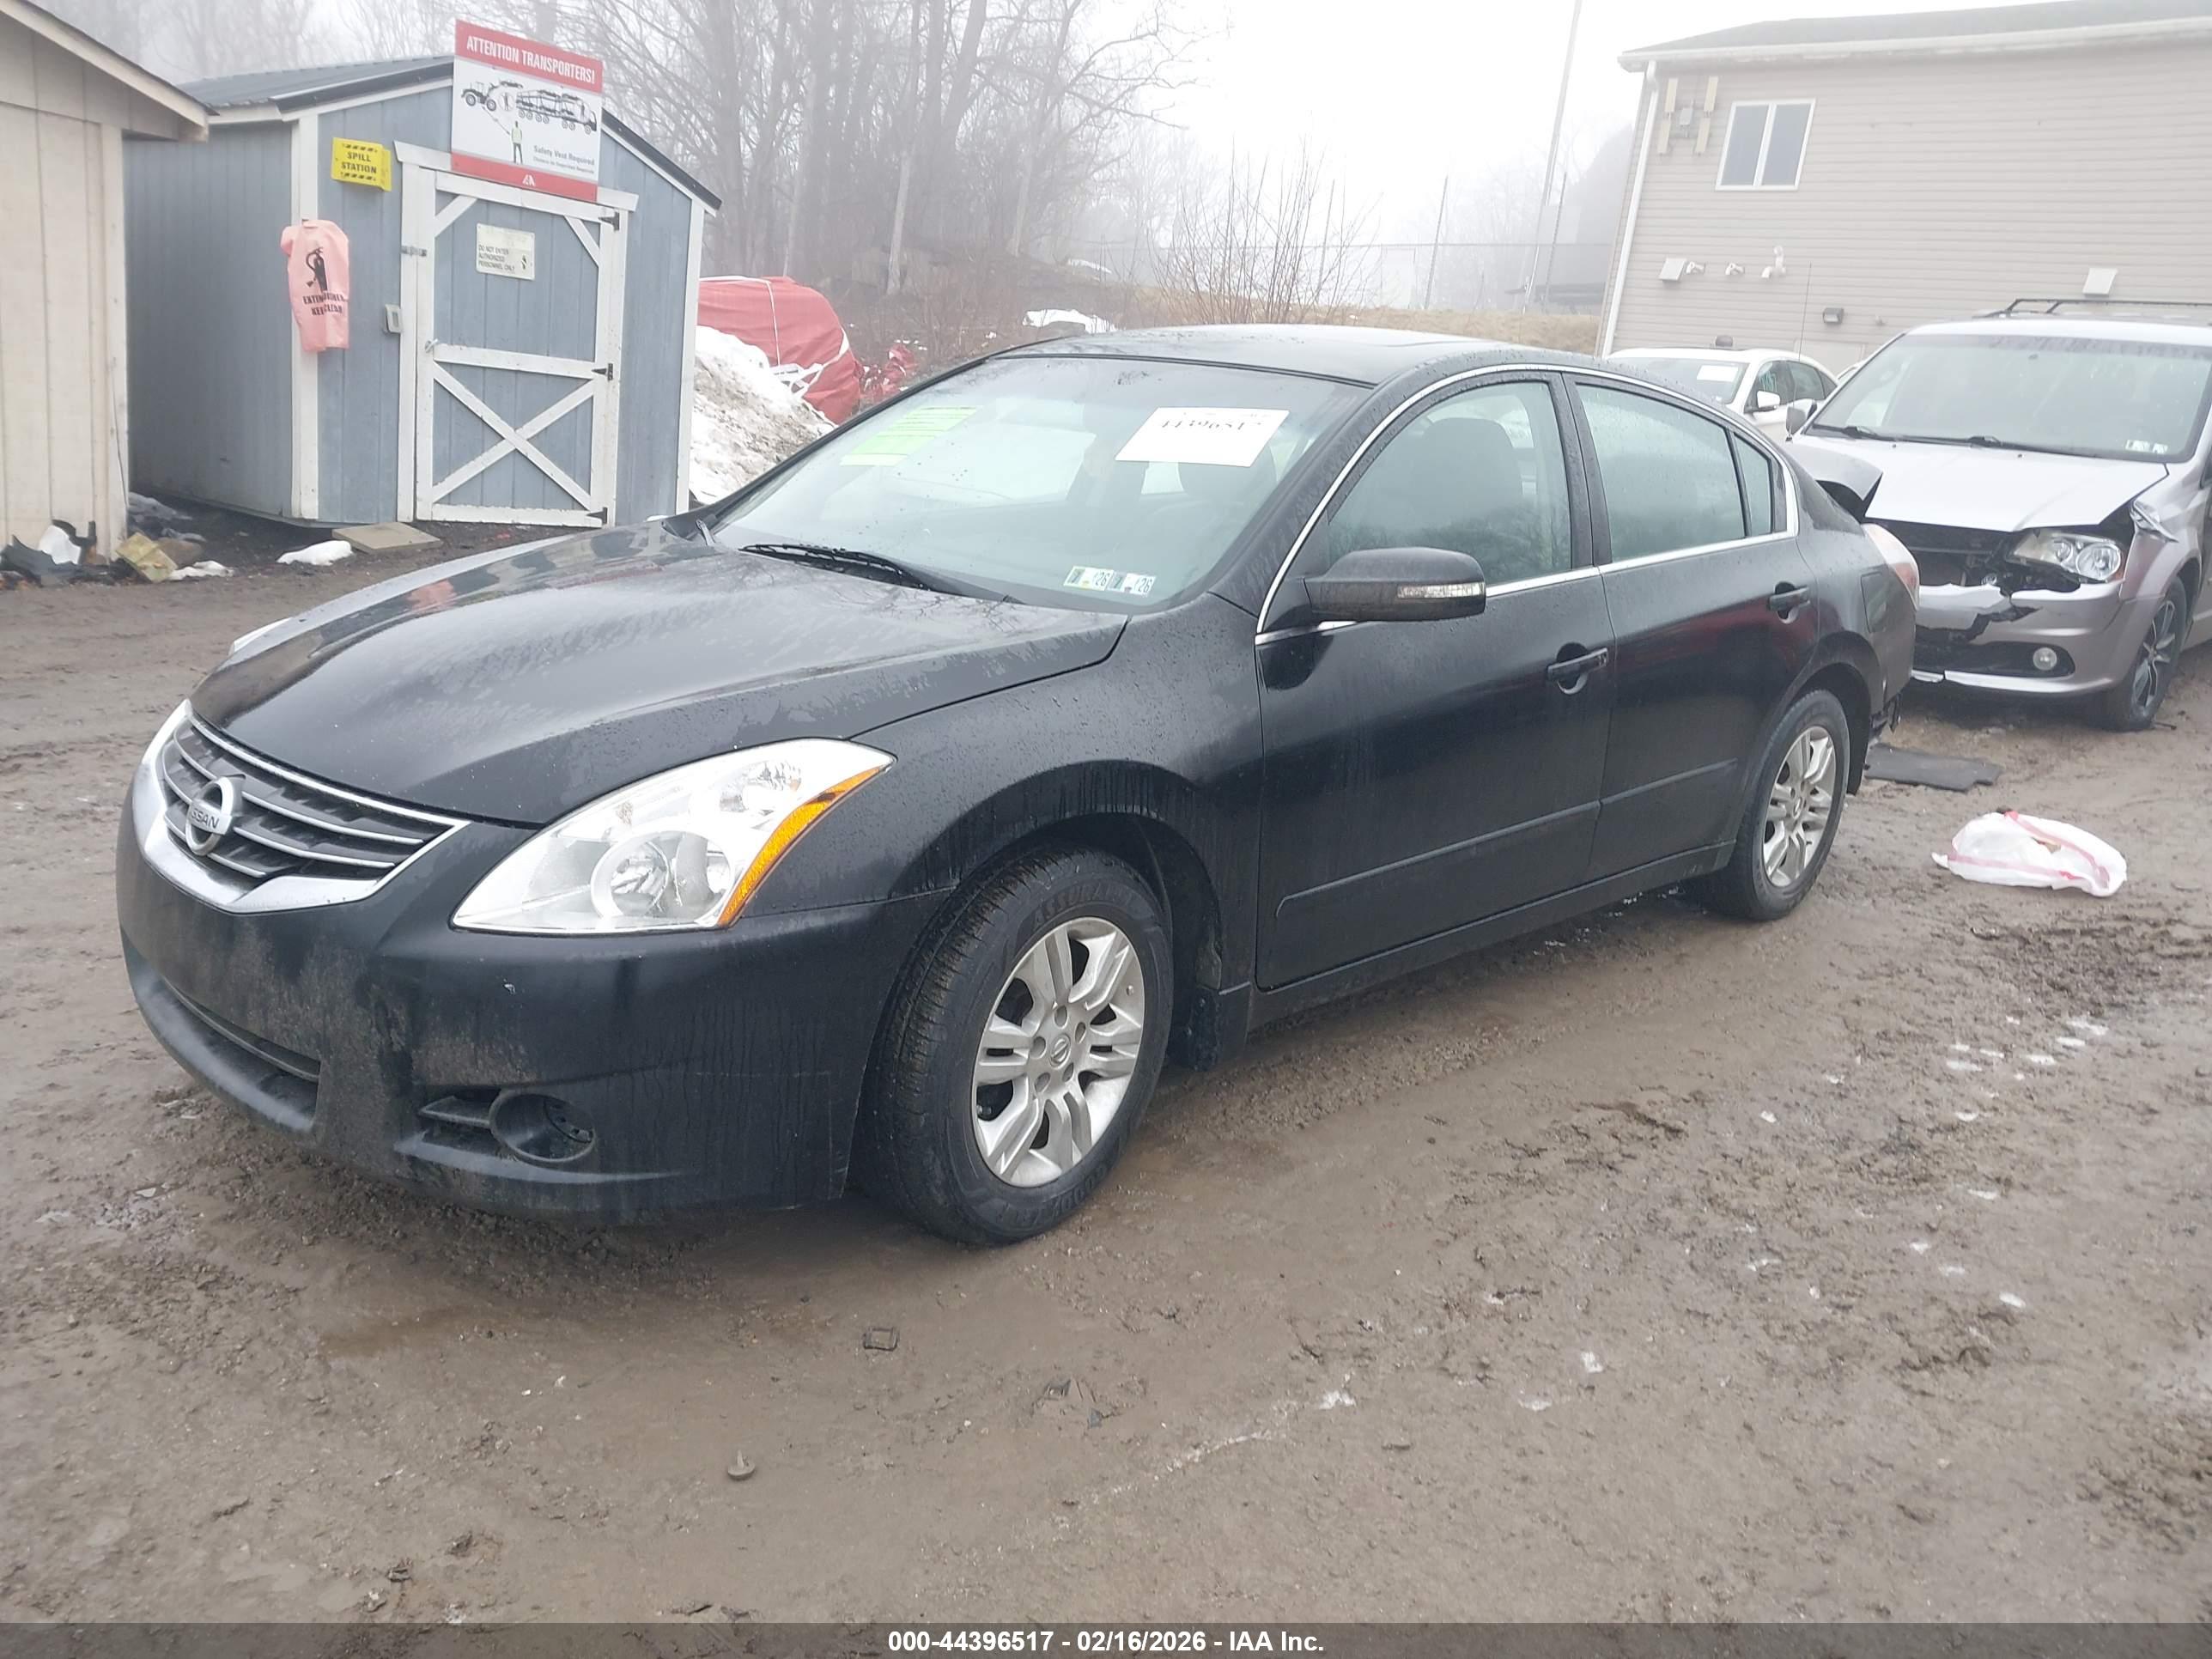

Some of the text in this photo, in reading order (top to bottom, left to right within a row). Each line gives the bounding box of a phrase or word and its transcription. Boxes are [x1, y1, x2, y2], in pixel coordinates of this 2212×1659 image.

[466, 35, 595, 84] ATTENTION TRANSPORTERS!
[347, 151, 371, 162] SPILL
[341, 161, 377, 174] STATION
